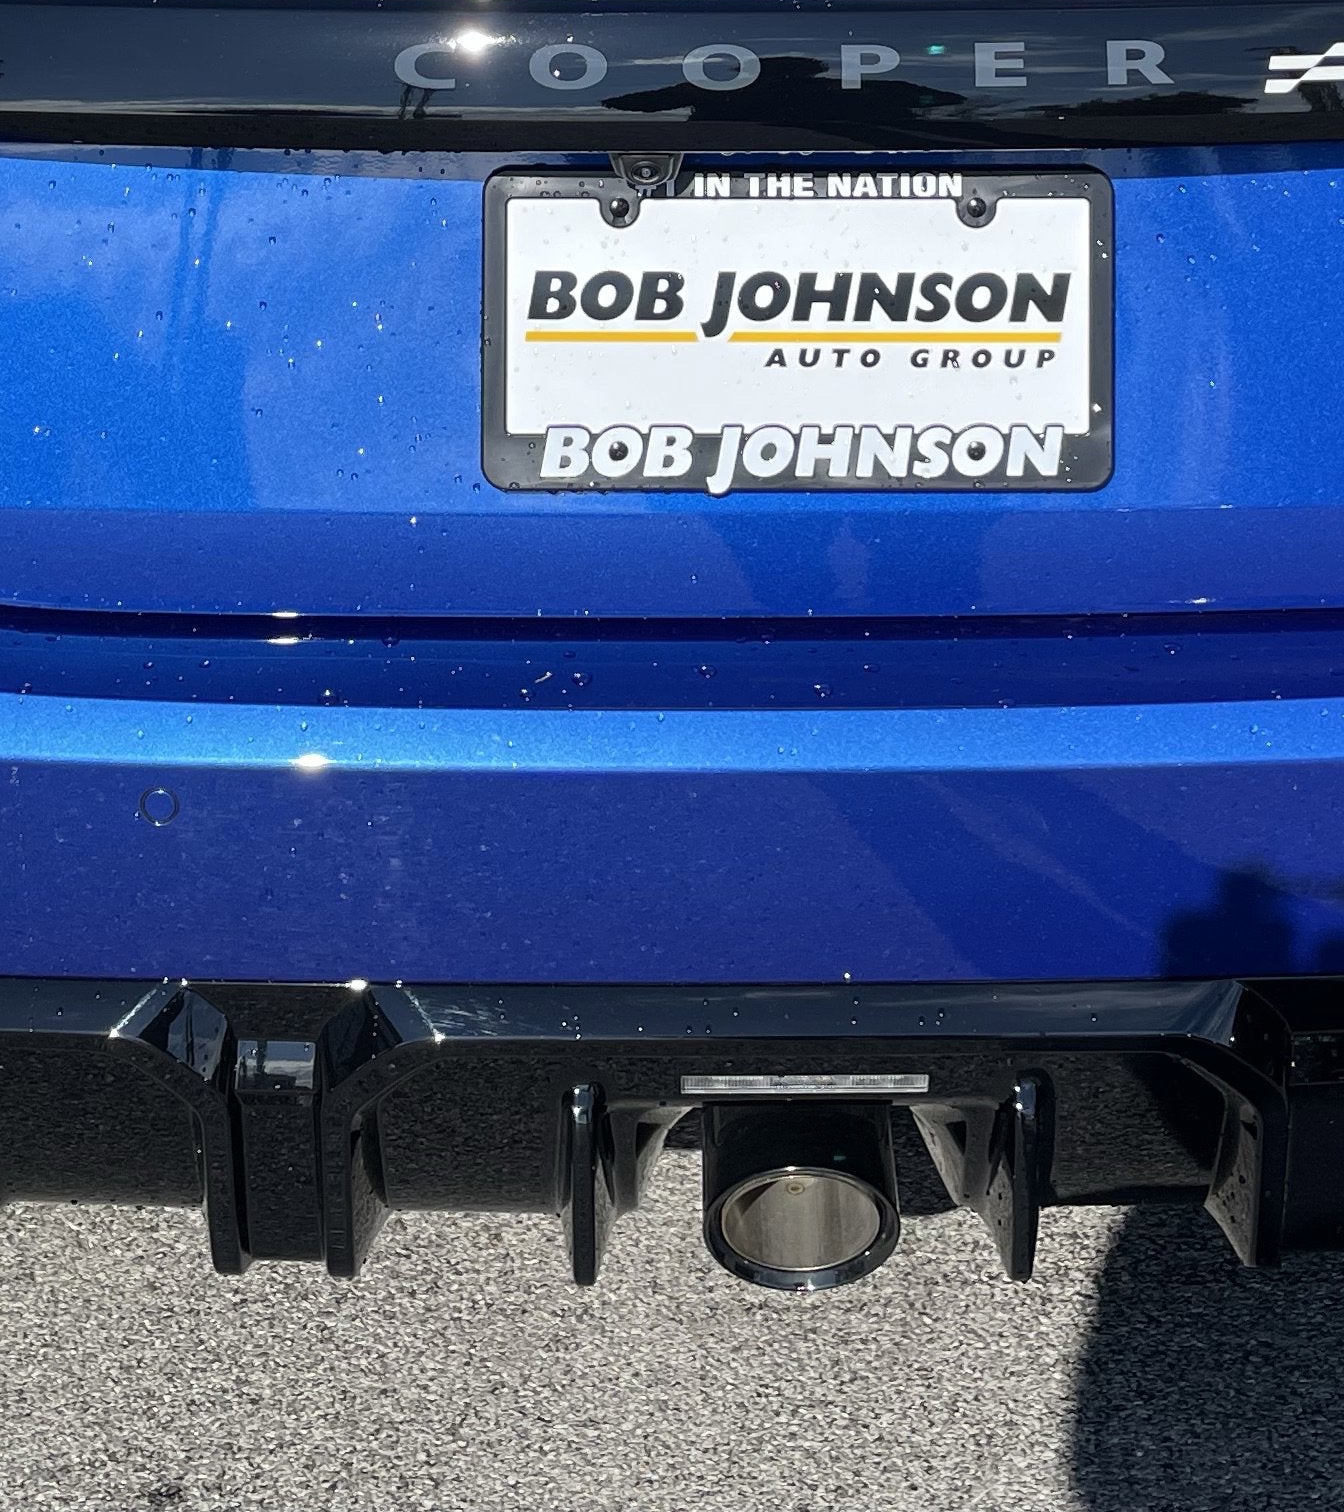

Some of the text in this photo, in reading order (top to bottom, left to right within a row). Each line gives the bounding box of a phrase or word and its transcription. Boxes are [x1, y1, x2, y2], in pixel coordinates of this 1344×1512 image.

[394, 39, 1175, 90] COOPER
[694, 172, 731, 197] IN
[743, 172, 814, 197] THE
[827, 172, 963, 197] NATION
[527, 270, 1071, 338] BOB JOHNSON
[765, 348, 1057, 368] AUTO GROUP
[538, 424, 1065, 496] BOB JOHNSON
